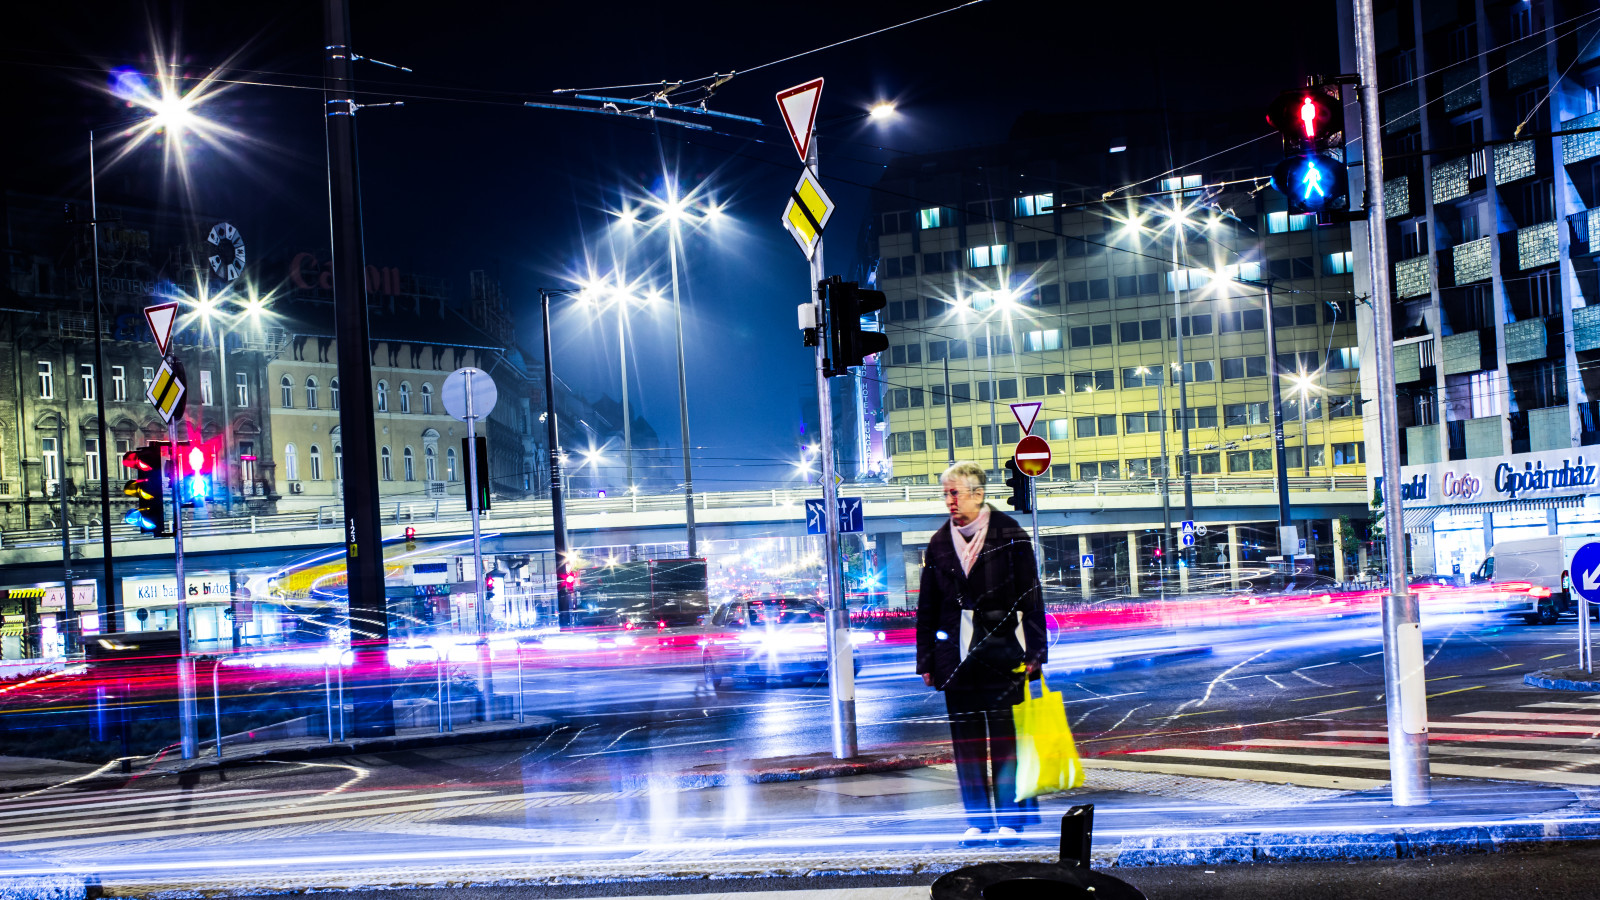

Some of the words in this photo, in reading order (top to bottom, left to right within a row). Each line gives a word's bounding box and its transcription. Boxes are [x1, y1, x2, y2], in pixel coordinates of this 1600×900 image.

[289, 252, 401, 296] Caon
[1442, 472, 1480, 499] Corso
[138, 584, 158, 599] K&H
[162, 584, 178, 597] ban
[188, 583, 199, 596] és
[203, 581, 230, 595] biztos
